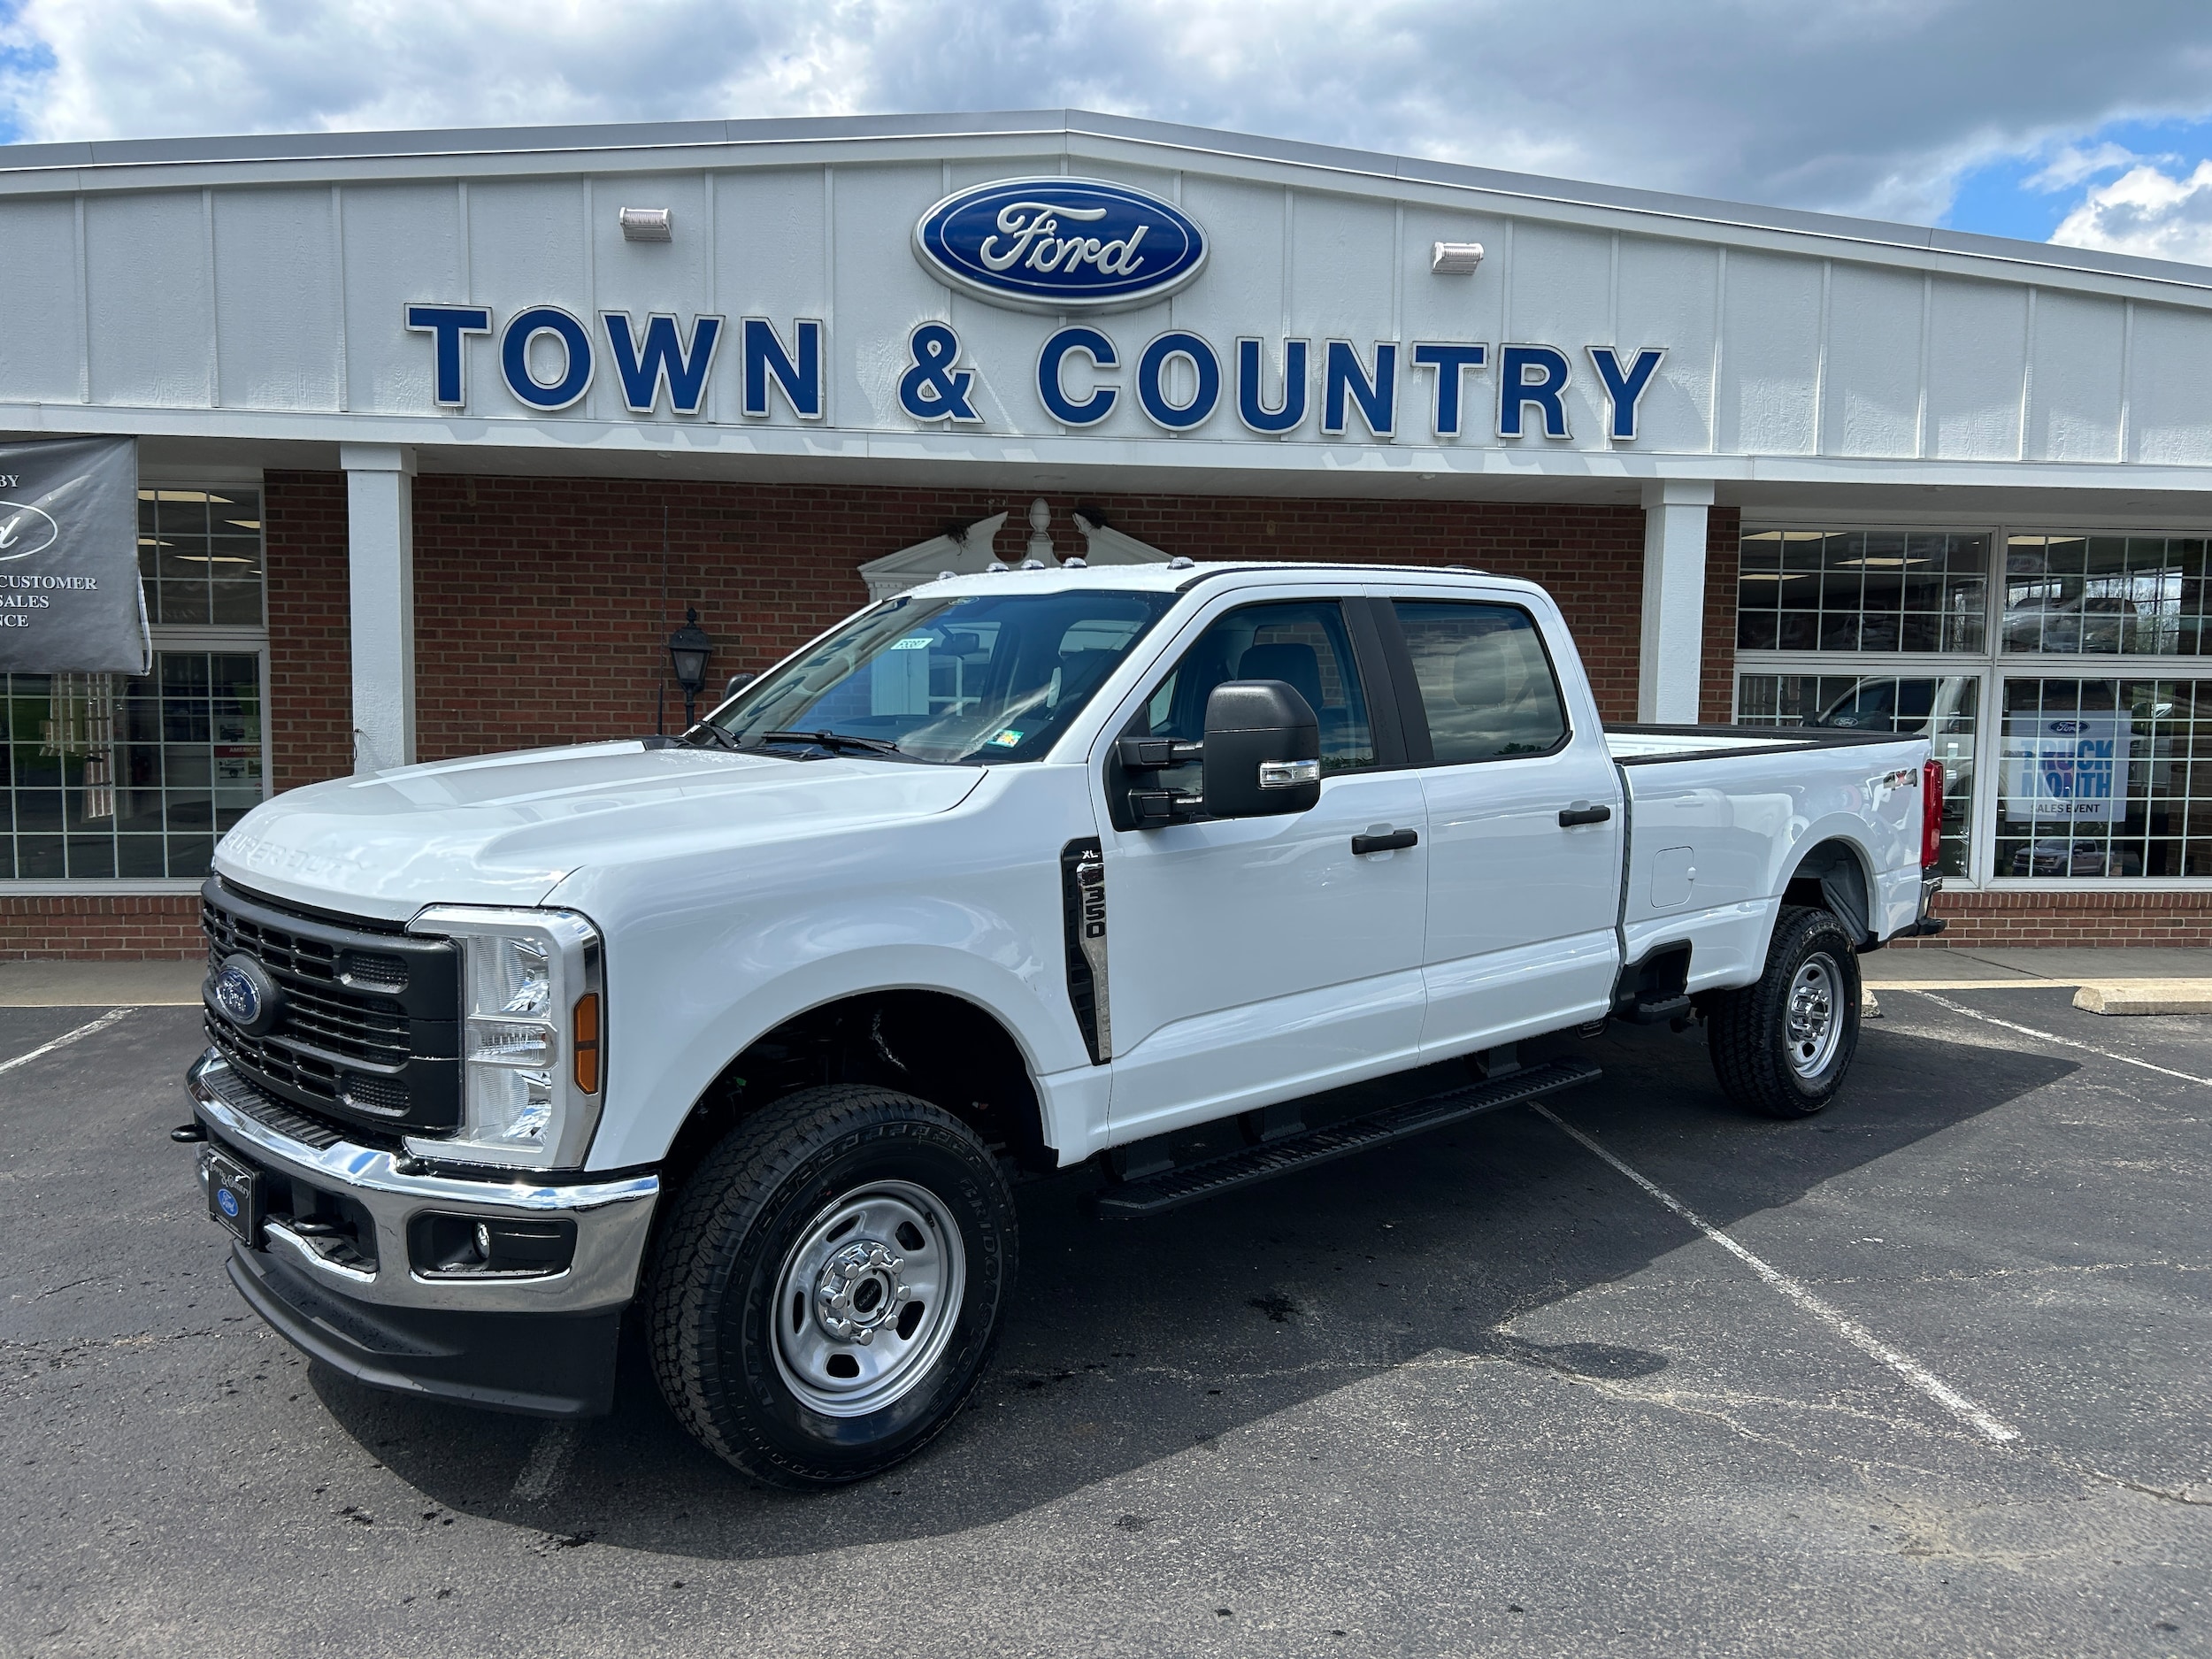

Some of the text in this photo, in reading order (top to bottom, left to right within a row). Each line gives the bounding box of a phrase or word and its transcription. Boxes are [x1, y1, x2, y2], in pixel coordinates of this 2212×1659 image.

[980, 202, 1149, 276] Ford
[403, 303, 1670, 442] TOWN & COUNTRY
[0, 574, 98, 590] CUSTOMER
[2056, 721, 2082, 733] Ford
[2021, 740, 2115, 771] TRUCK
[2021, 772, 2111, 798] MONTH
[2030, 803, 2101, 813] SALES EVENT
[1081, 849, 1099, 860] XL
[222, 974, 248, 1013] Ford
[222, 1191, 235, 1213] Ford
